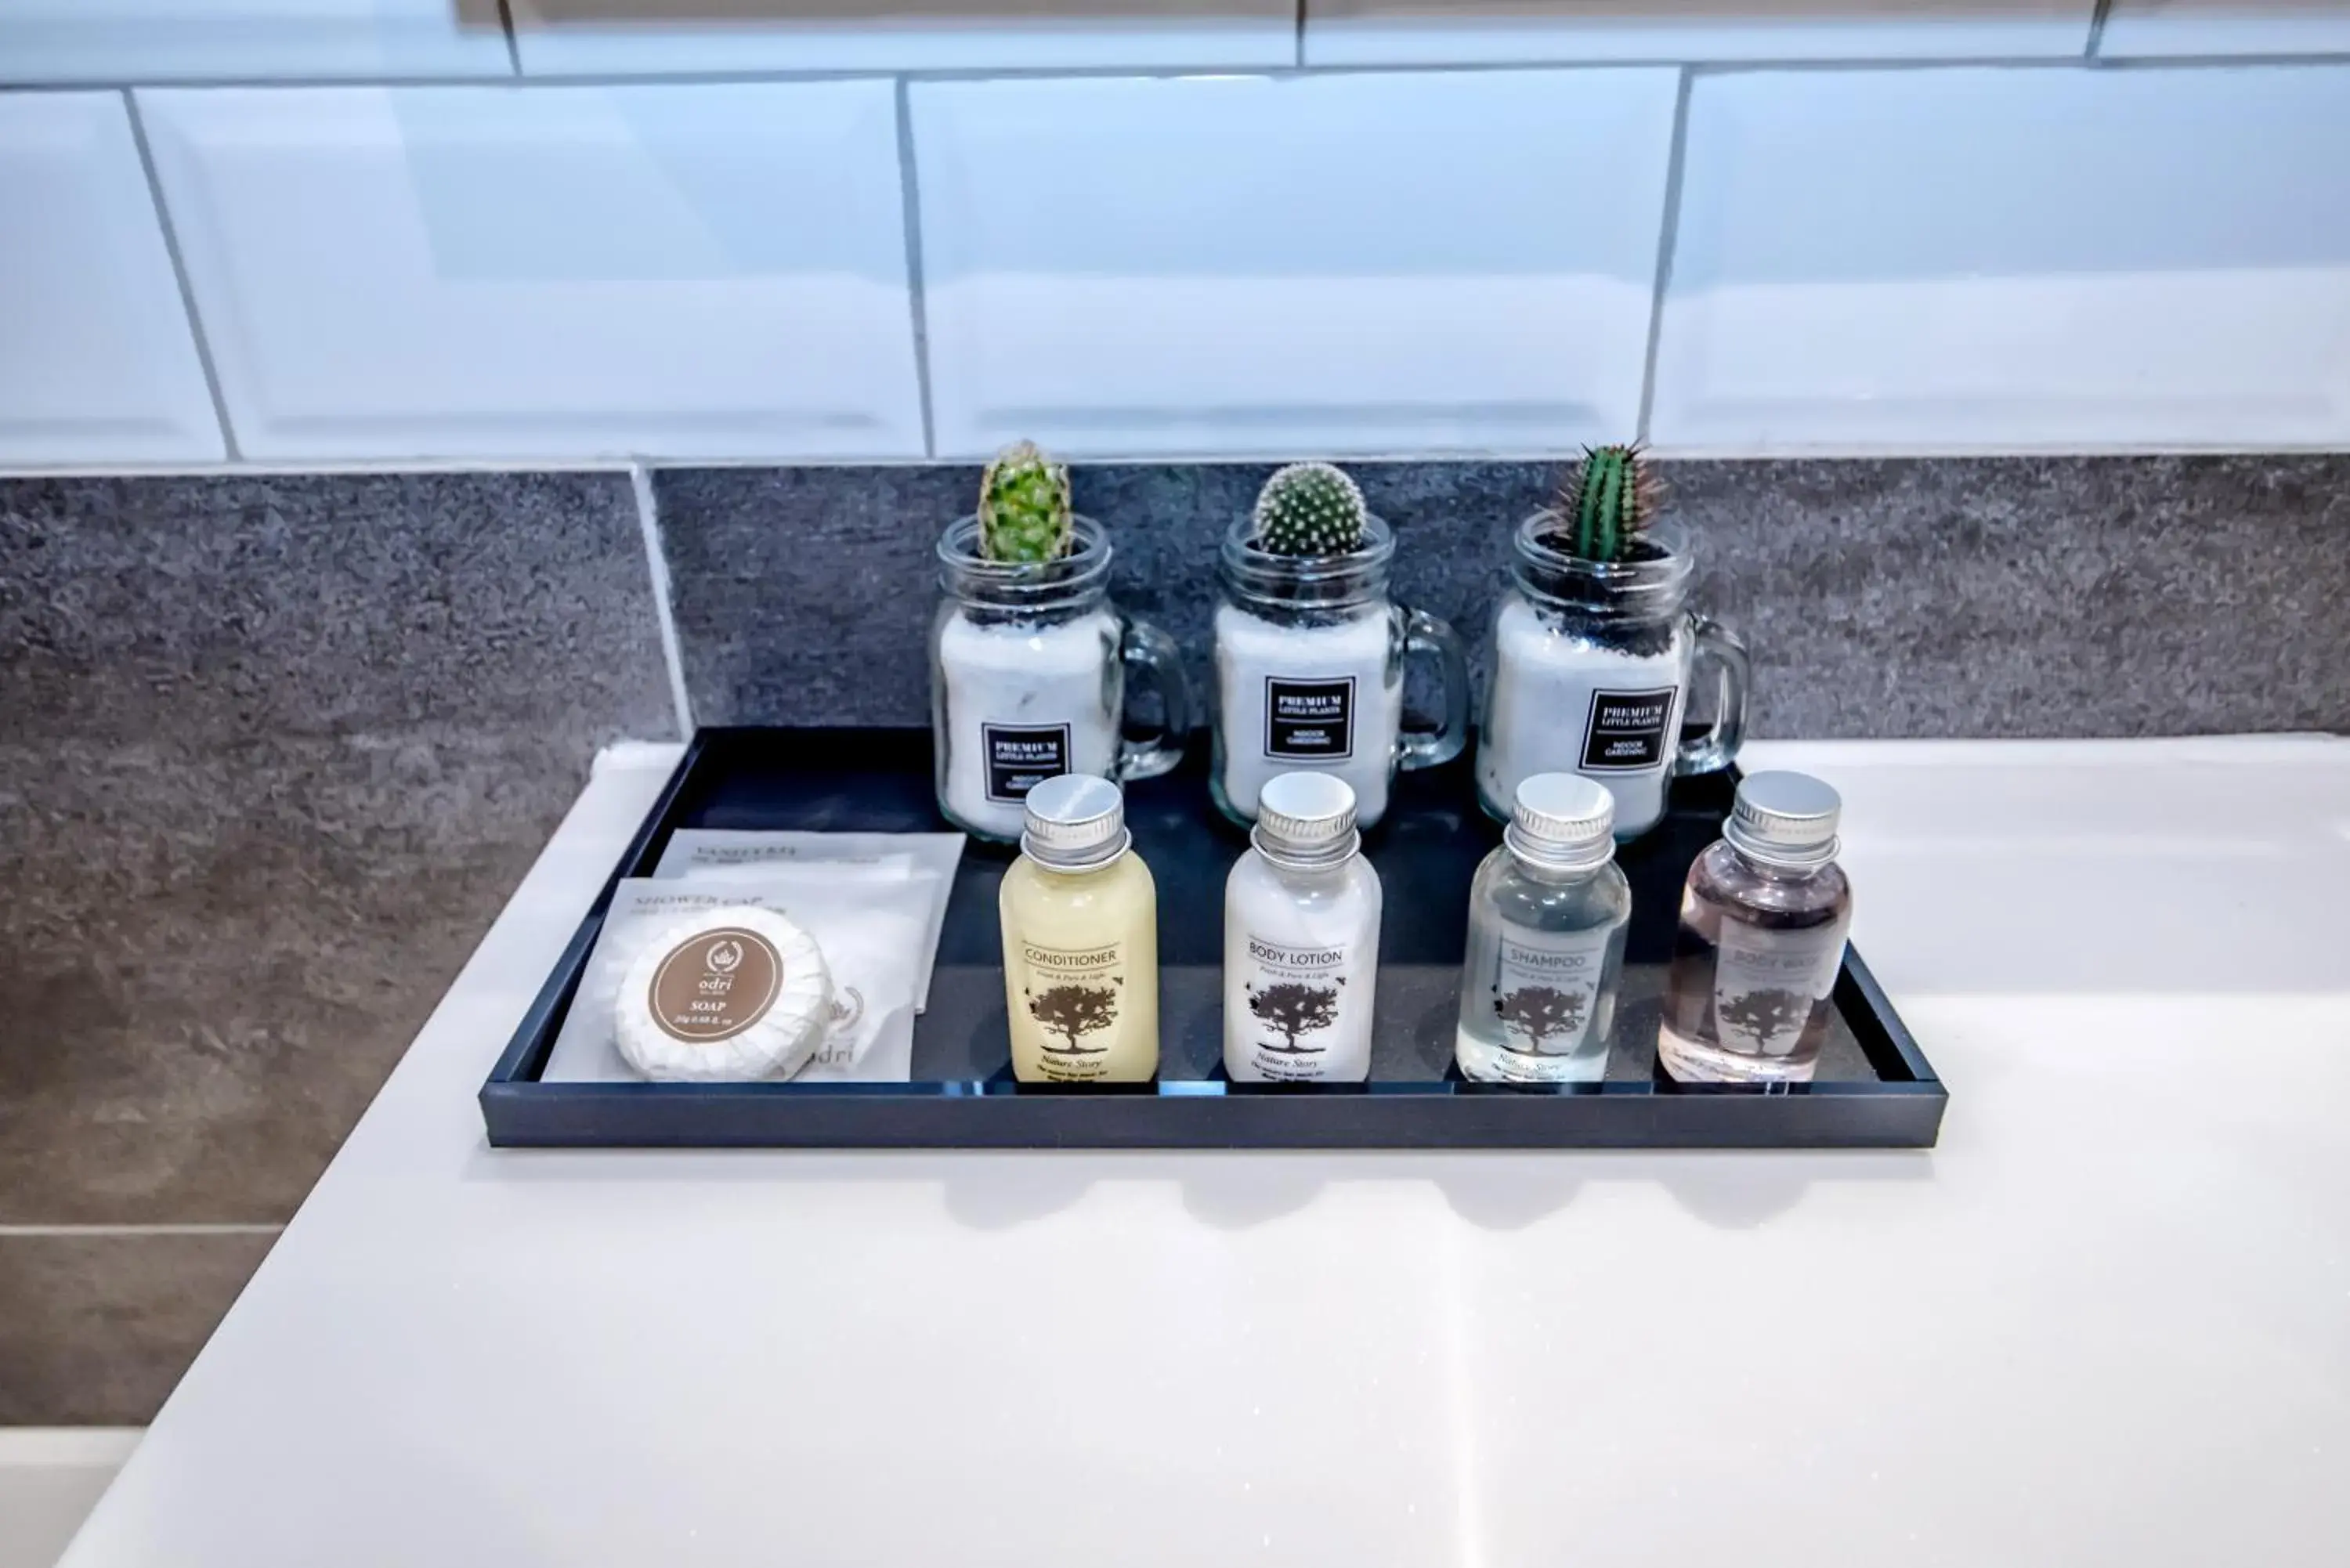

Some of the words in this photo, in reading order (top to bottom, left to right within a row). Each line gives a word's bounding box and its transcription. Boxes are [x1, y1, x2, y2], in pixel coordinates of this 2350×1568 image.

[1278, 695, 1341, 706] PREMIUM
[1278, 706, 1307, 714] LITTLE
[1603, 704, 1662, 717] PREMIUM
[1602, 717, 1629, 727] LITTLE
[996, 741, 1058, 752] PREMIUM
[1025, 948, 1116, 966] CONDITIONER
[1249, 941, 1285, 963] BODY
[1290, 951, 1342, 966] LOTION
[1509, 948, 1586, 967] SHAMPOO
[699, 977, 732, 991] odri
[689, 1000, 727, 1012] SOAP
[811, 1044, 854, 1064] dri
[1256, 1052, 1291, 1067] Nature
[1041, 1054, 1072, 1068] Nature
[1076, 1058, 1103, 1070] Story
